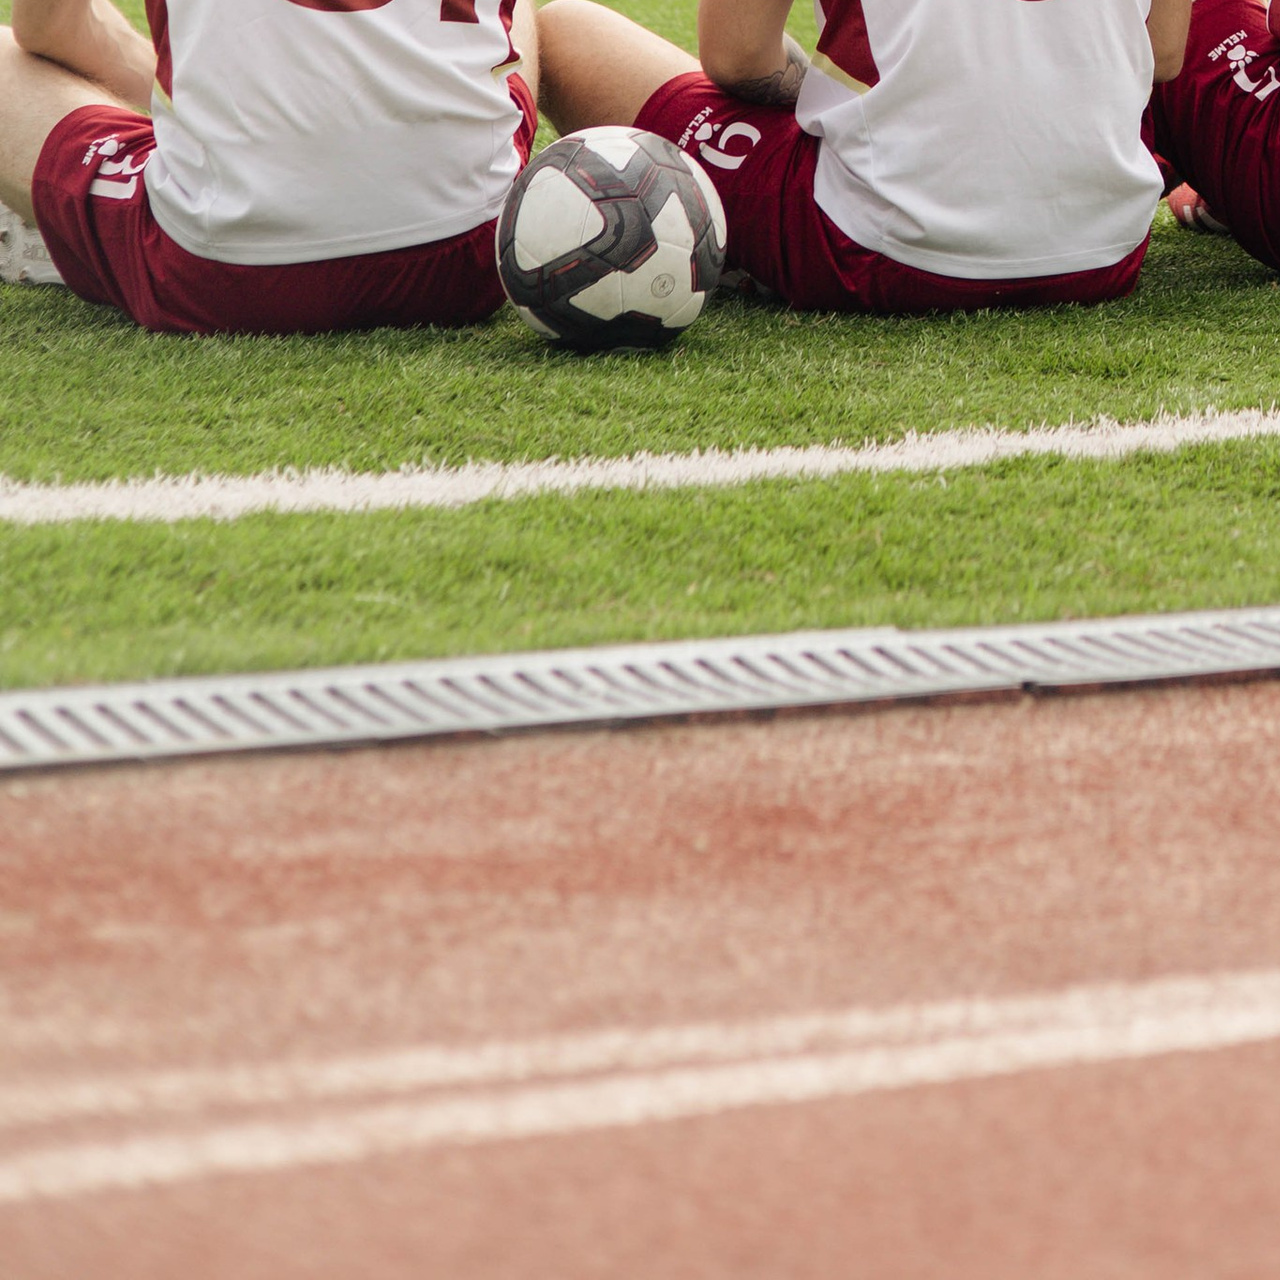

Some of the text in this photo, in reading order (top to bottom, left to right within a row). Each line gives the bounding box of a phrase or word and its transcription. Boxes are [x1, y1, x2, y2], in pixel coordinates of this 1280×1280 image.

[1207, 29, 1248, 61] KELME
[677, 106, 714, 149] KELME
[699, 121, 762, 170] 9
